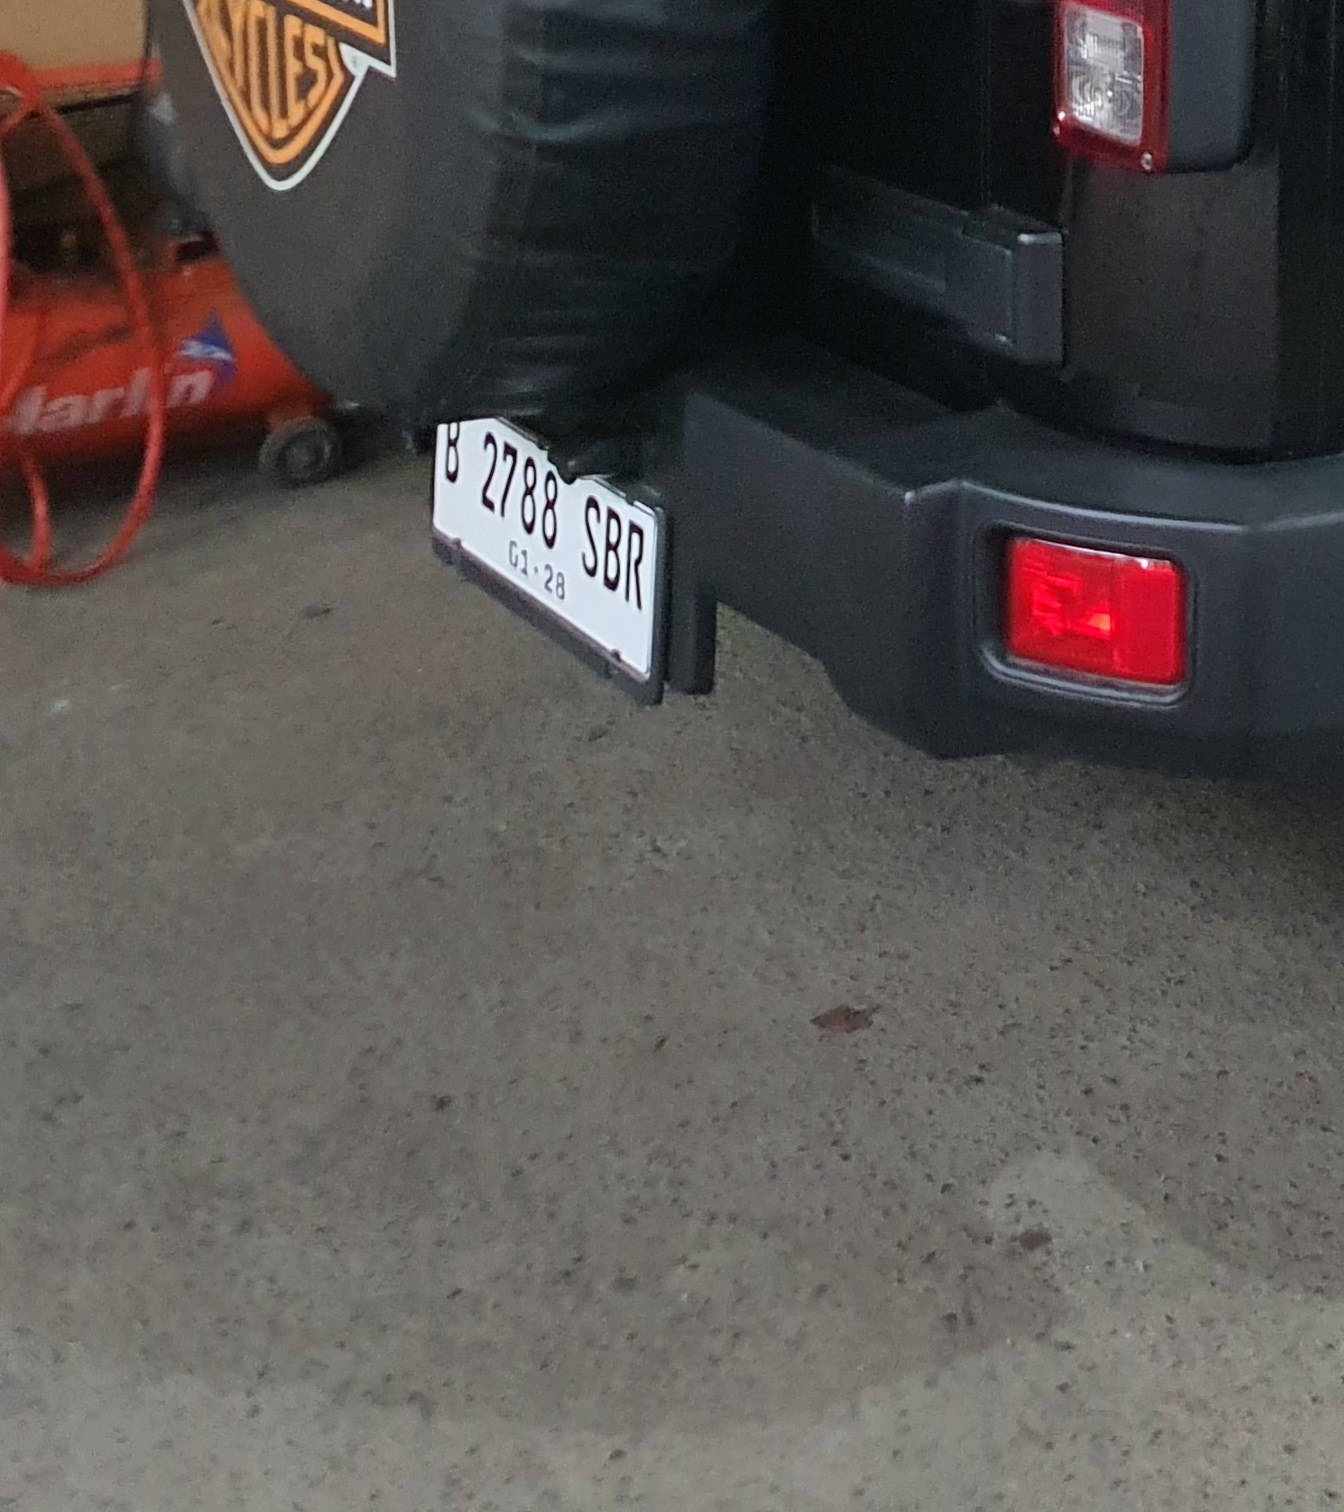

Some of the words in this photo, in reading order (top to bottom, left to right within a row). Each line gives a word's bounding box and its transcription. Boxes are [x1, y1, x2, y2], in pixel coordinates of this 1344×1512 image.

[445, 422, 461, 484] B
[481, 431, 559, 550] 2788
[581, 494, 645, 611] SBR
